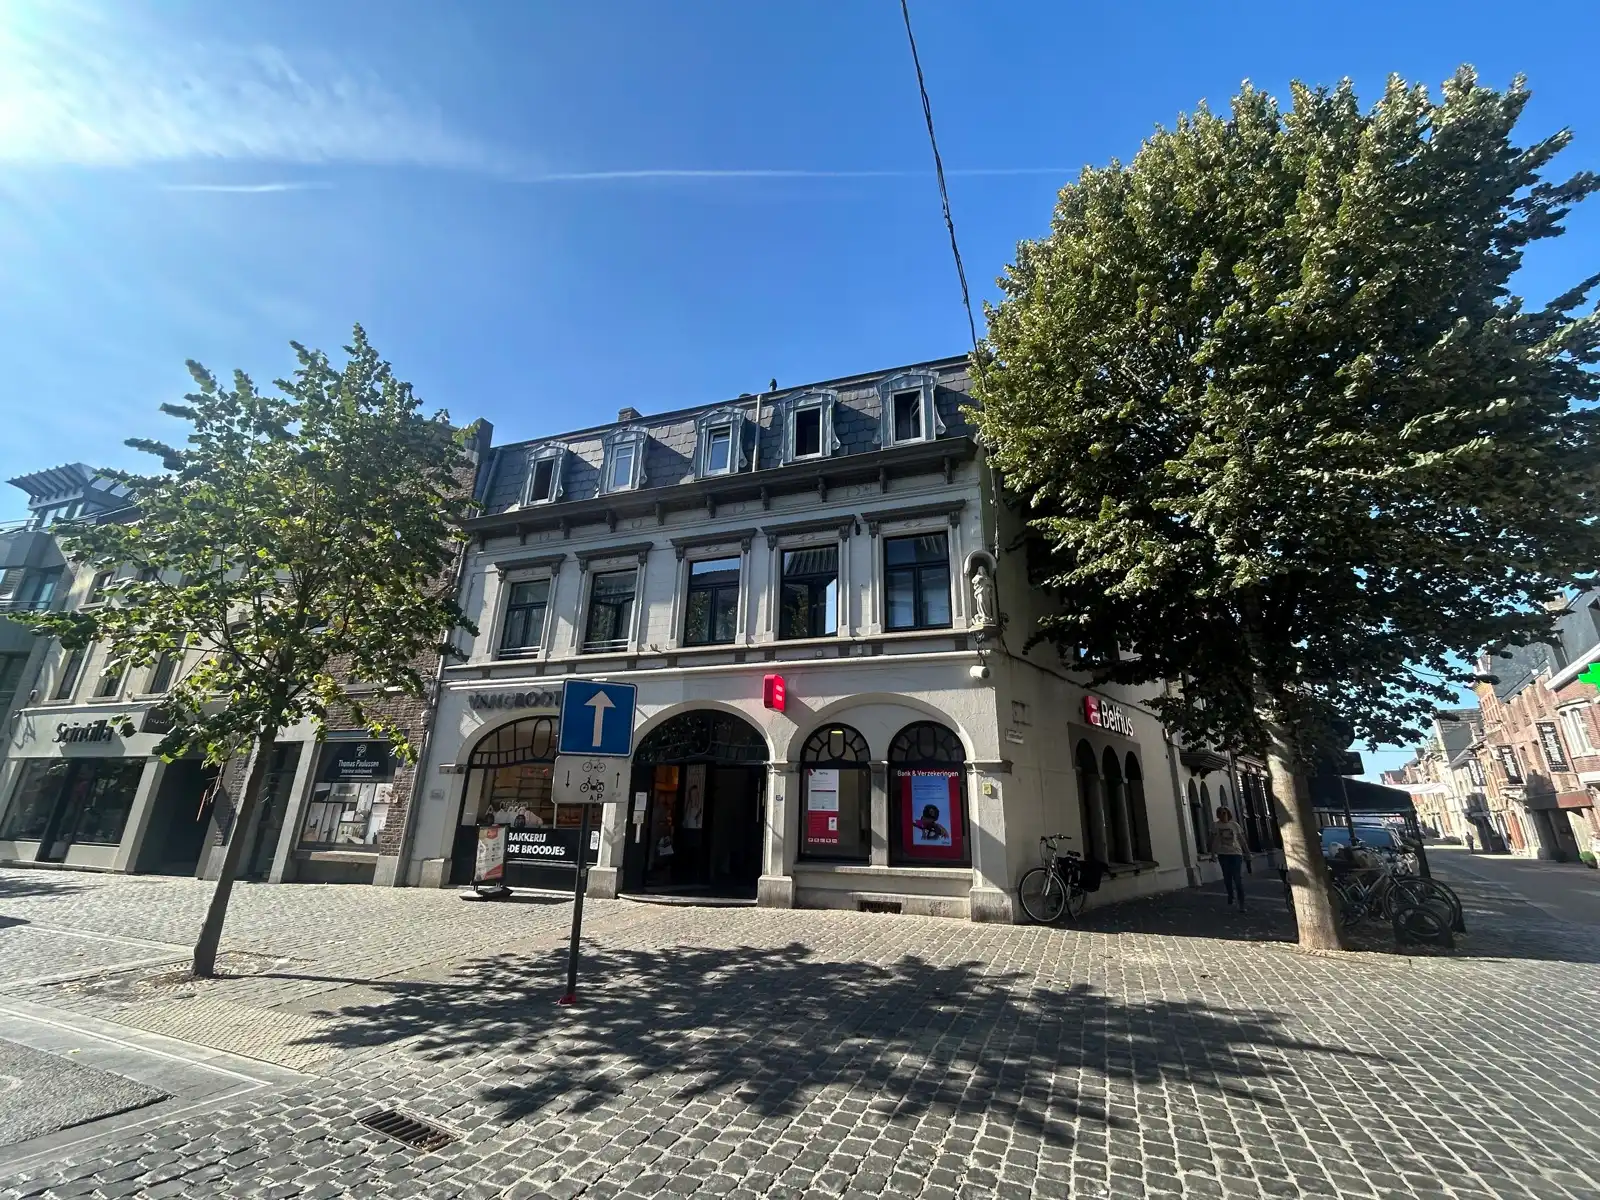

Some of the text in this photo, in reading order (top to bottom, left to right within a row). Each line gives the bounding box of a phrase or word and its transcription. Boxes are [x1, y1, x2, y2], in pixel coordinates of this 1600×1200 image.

[1101, 700, 1134, 737] Belfius
[52, 720, 114, 742] Scintilla
[917, 770, 959, 778] Verzekeringen
[508, 832, 547, 843] BAKKERIJ
[521, 845, 566, 856] BROODJES
